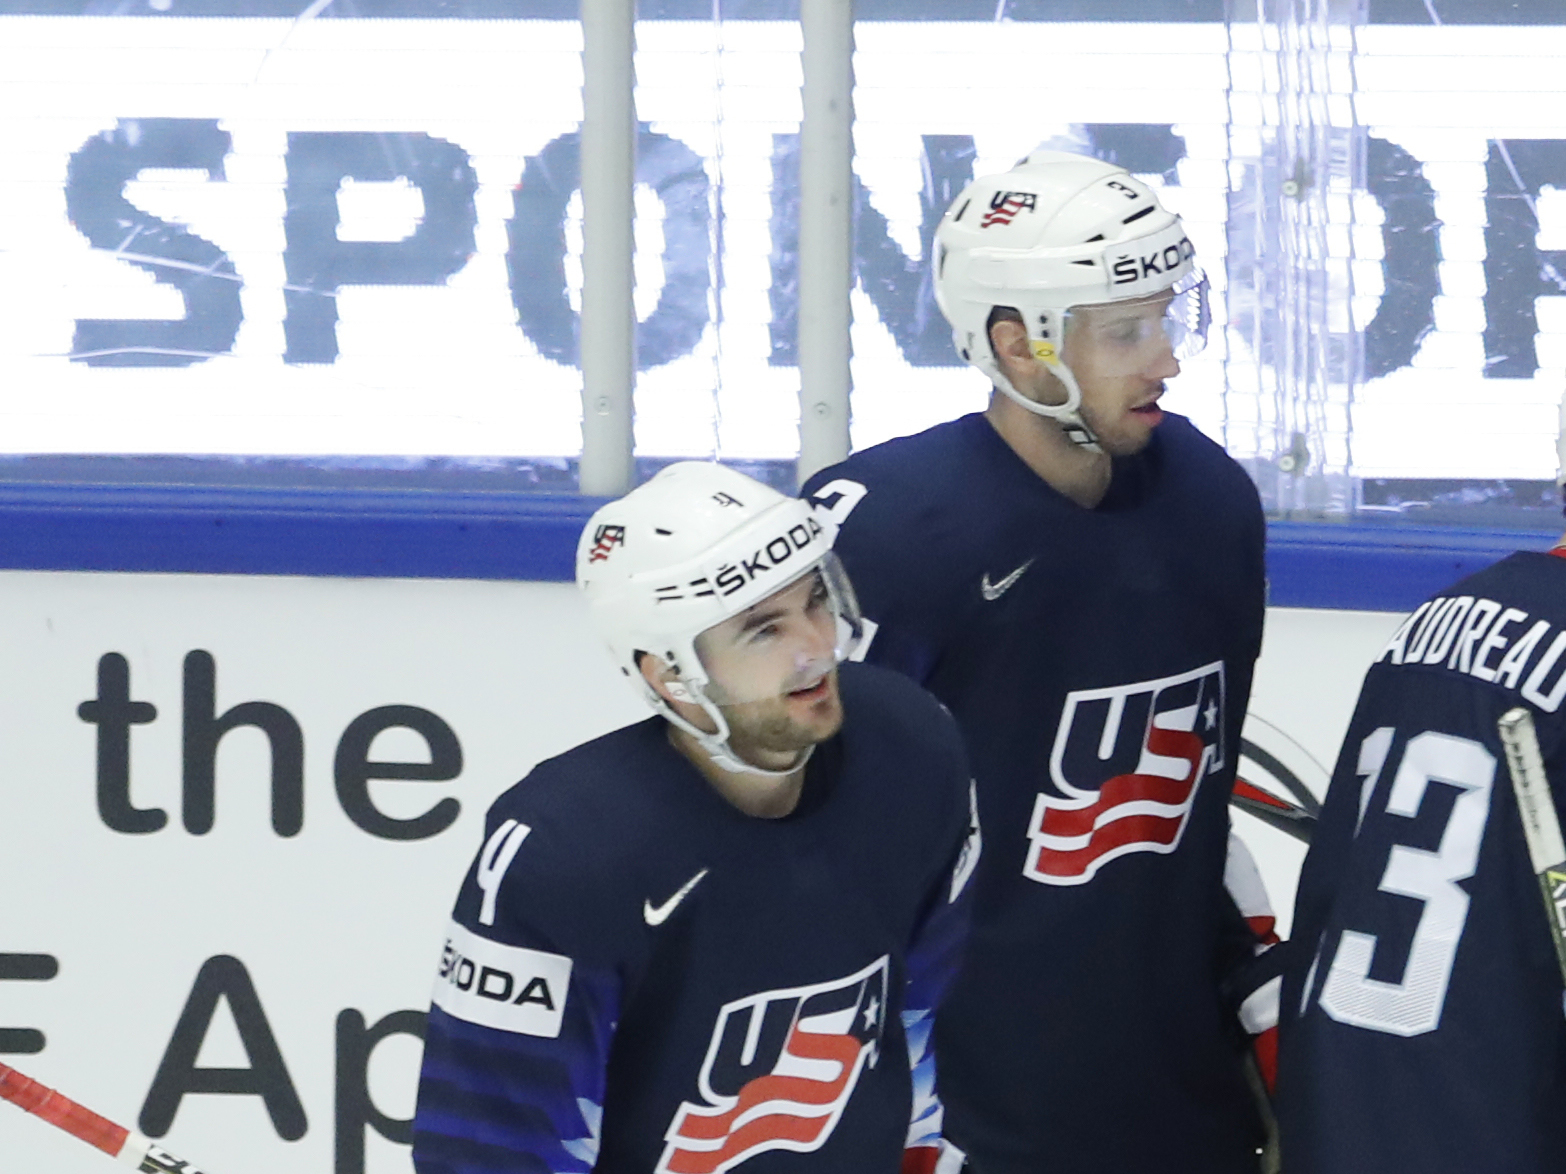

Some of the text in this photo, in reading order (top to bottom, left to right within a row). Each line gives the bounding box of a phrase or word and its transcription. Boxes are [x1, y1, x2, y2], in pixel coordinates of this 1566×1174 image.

[715, 516, 824, 597] ŠKODA
[77, 649, 464, 840] the
[476, 818, 532, 927] 4
